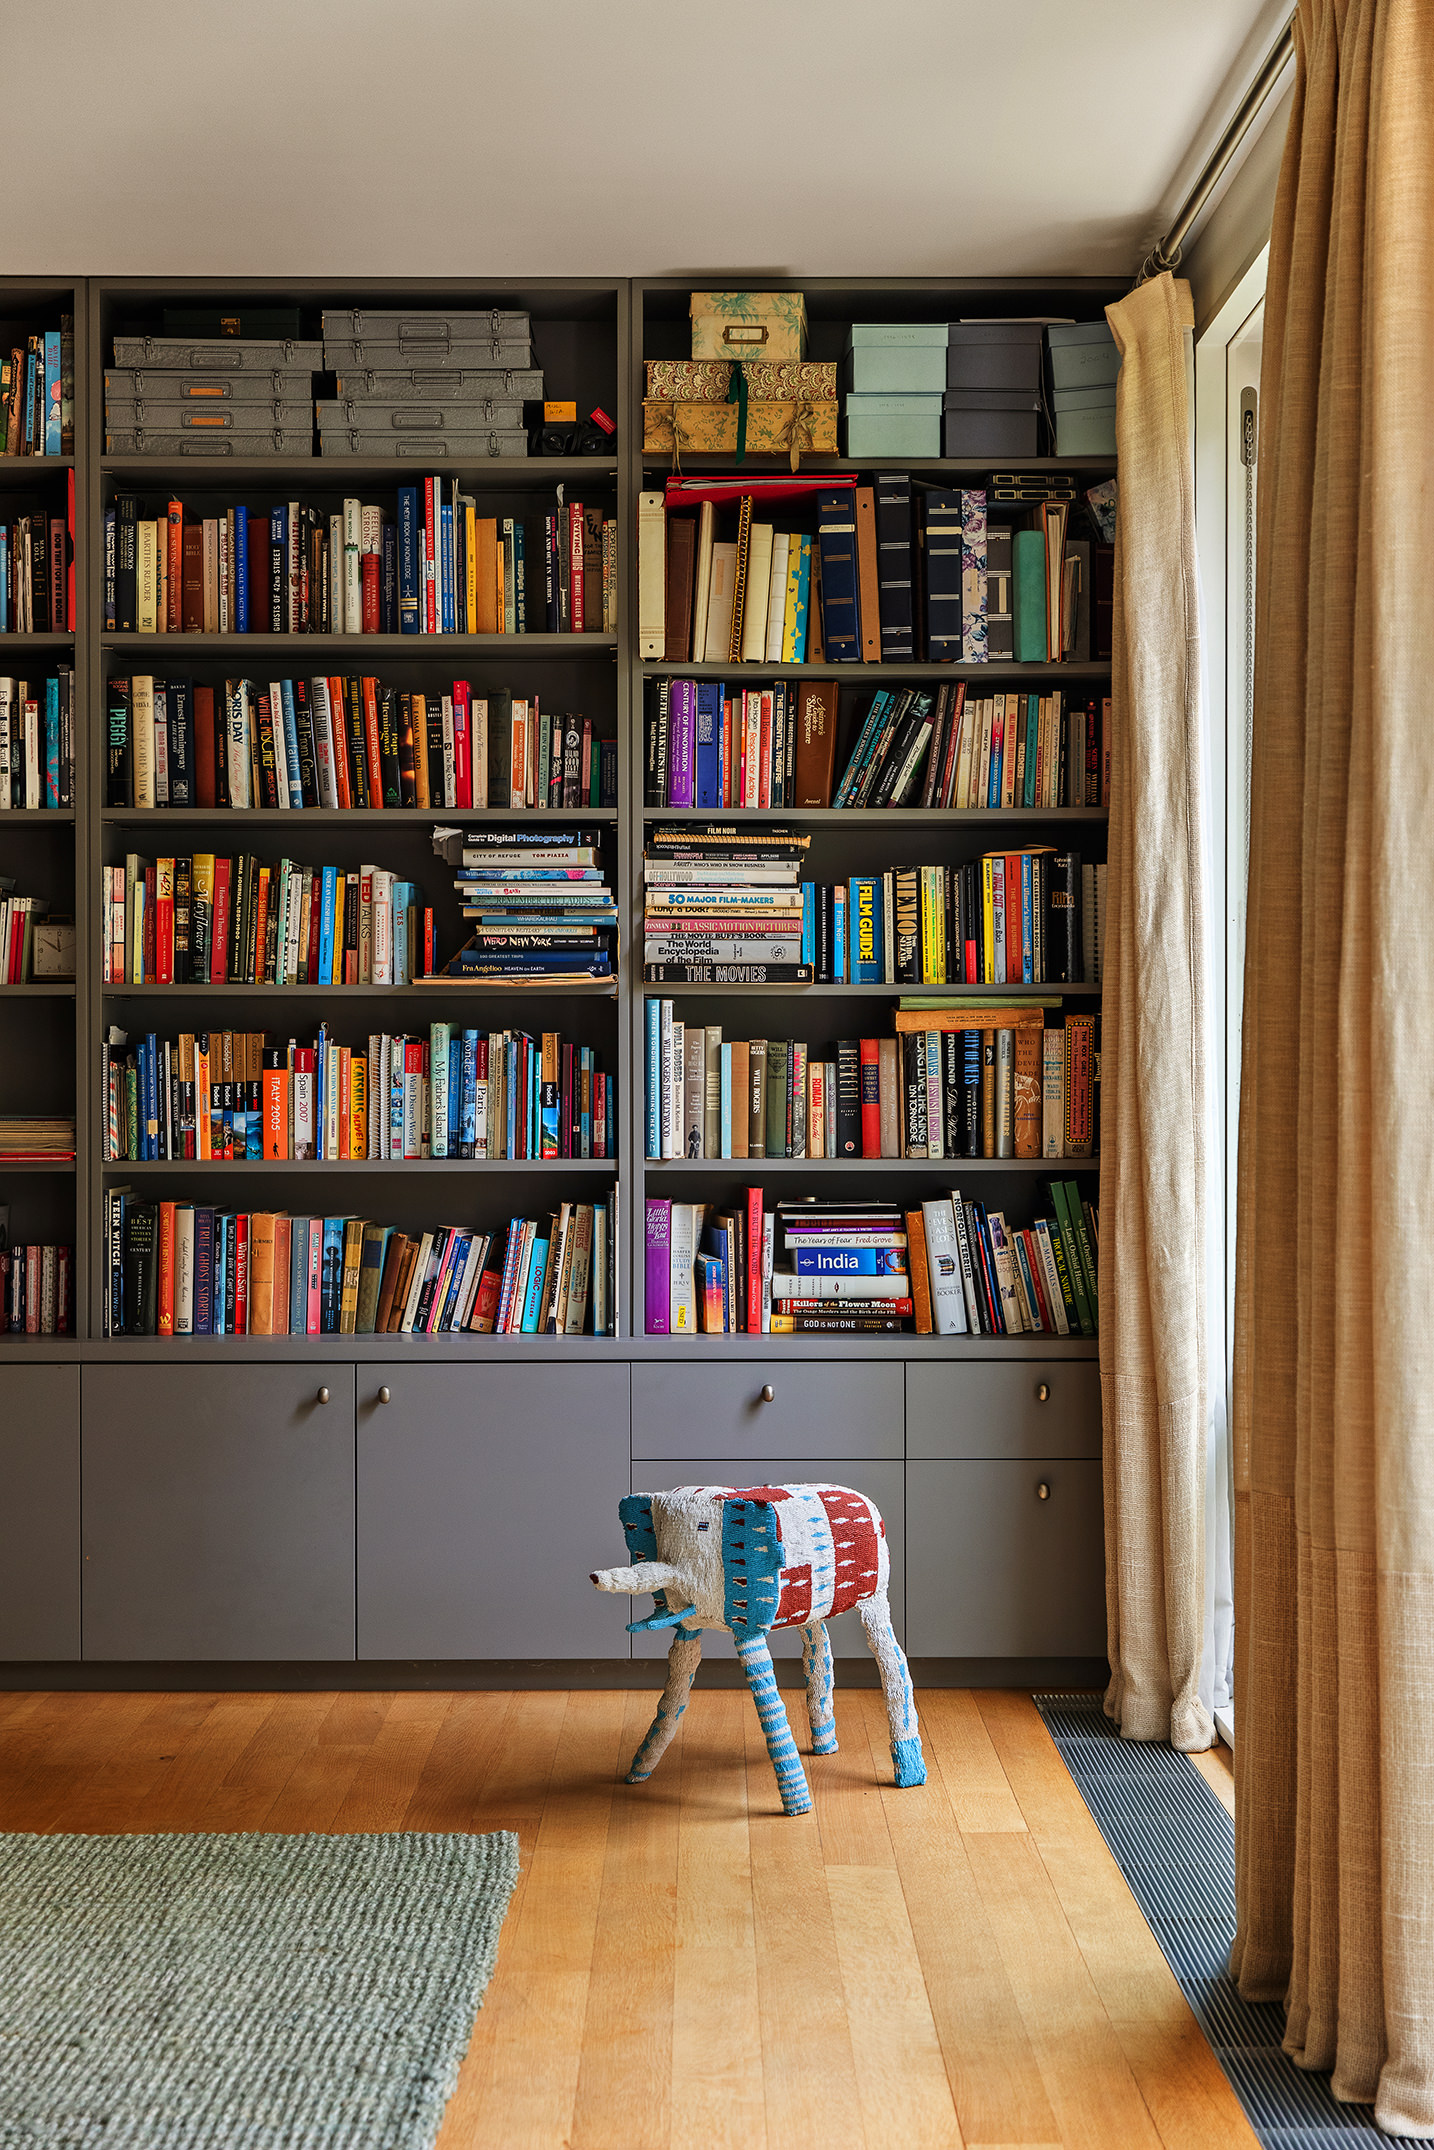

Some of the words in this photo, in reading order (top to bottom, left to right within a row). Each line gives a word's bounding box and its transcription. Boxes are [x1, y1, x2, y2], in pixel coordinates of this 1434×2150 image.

[363, 511, 371, 545] STRONG
[371, 511, 379, 545] FEELING
[53, 533, 62, 549] NOW
[143, 532, 151, 569] BARTHES
[53, 550, 62, 566] THAT
[143, 570, 151, 602] READER
[348, 578, 353, 587] US
[54, 598, 63, 624] WOMAN
[283, 691, 292, 705] the
[297, 681, 306, 703] BAILEY
[682, 682, 690, 715] CENTURY
[176, 693, 186, 720] Ernest
[284, 707, 294, 731] future
[297, 709, 310, 728] Fall
[816, 697, 826, 736] Asimov's
[109, 707, 128, 748] PEGGY
[379, 701, 391, 757] Hemingway
[682, 715, 689, 726] OF
[751, 710, 759, 730] Hagen
[804, 694, 817, 745] Shakespeare
[177, 721, 187, 770] Hemingway
[287, 733, 295, 742] of
[298, 731, 312, 757] From
[391, 732, 399, 756] Papa
[681, 727, 689, 772] INNOVATION
[746, 732, 757, 762] Respect
[288, 743, 299, 771] faith
[748, 764, 757, 775] for
[1017, 742, 1026, 779] EISENSTEIN
[301, 758, 314, 787] Grace
[746, 775, 756, 799] Acting
[487, 833, 516, 844] Digital
[516, 833, 575, 844] Photography
[707, 827, 723, 835] FILM
[722, 827, 737, 835] NOIR
[158, 871, 171, 897] 1421
[361, 874, 372, 903] TED
[992, 872, 1003, 892] FINAL
[216, 886, 226, 907] History
[668, 894, 686, 904] 50
[686, 896, 717, 904] MAJOR
[718, 896, 775, 904] FILM-MAKERS
[859, 885, 873, 916] FILM
[896, 870, 917, 936] MEMO
[993, 893, 1004, 909] CUT
[193, 879, 210, 952] Mayflower
[217, 908, 225, 916] in
[361, 904, 372, 939] TALKS
[396, 909, 404, 926] YES
[994, 911, 1003, 929] Steven
[216, 917, 224, 934] Three
[995, 930, 1003, 944] Bach
[216, 936, 224, 950] Keys
[482, 935, 508, 947] WEIRD
[509, 936, 530, 946] NEW
[530, 936, 552, 947] YORK
[666, 940, 686, 948] The
[687, 940, 712, 948] World
[859, 917, 873, 960] GUIDE
[658, 947, 720, 956] Encyclopedia
[665, 956, 676, 964] of
[677, 956, 692, 964] the
[693, 956, 713, 964] Film
[685, 966, 712, 982] THE
[715, 966, 767, 982] MOVIES
[663, 1038, 671, 1056] WILL
[964, 1029, 980, 1050] CITY
[432, 1060, 446, 1077] My
[462, 1038, 475, 1075] yonder
[947, 1033, 956, 1085] PENTIMENTO
[964, 1051, 980, 1062] OF
[663, 1056, 671, 1084] ROGERS
[753, 1069, 761, 1086] WILL
[792, 1051, 806, 1099] MONTY
[964, 1063, 980, 1085] NETS
[271, 1077, 281, 1103] ITALY
[297, 1074, 308, 1099] Spain
[408, 1075, 417, 1094] Walt
[435, 1078, 446, 1110] Father's
[663, 1084, 671, 1094] IN
[812, 1078, 822, 1107] ROMAN
[299, 1101, 308, 1123] 2007
[407, 1094, 417, 1121] Disney
[477, 1087, 487, 1116] Paris
[753, 1087, 761, 1114] ROGERS
[271, 1104, 281, 1131] 2005
[435, 1111, 446, 1139] Island
[662, 1094, 671, 1138] HOLLYWOOD
[811, 1111, 823, 1140] Polanski
[408, 1120, 417, 1147] World
[112, 1200, 121, 1227] TEEN
[112, 1230, 121, 1266] WITCH
[198, 1226, 210, 1249] TRUE
[807, 1236, 827, 1244] Years
[827, 1236, 835, 1244] of
[836, 1236, 853, 1244] Fear
[855, 1236, 872, 1244] Fred
[871, 1236, 893, 1244] Grove
[953, 1198, 966, 1241] NORFOLK
[960, 1243, 972, 1280] TERRIER
[198, 1252, 210, 1283] GHOST
[817, 1253, 859, 1269] India
[1044, 1248, 1057, 1288] MAMMALS
[197, 1286, 210, 1323] STORIES
[422, 1281, 433, 1305] STORIES
[838, 1300, 869, 1308] Flower
[870, 1300, 897, 1308] Moon
[803, 1320, 820, 1328] GOD
[839, 1320, 856, 1329] ONE
